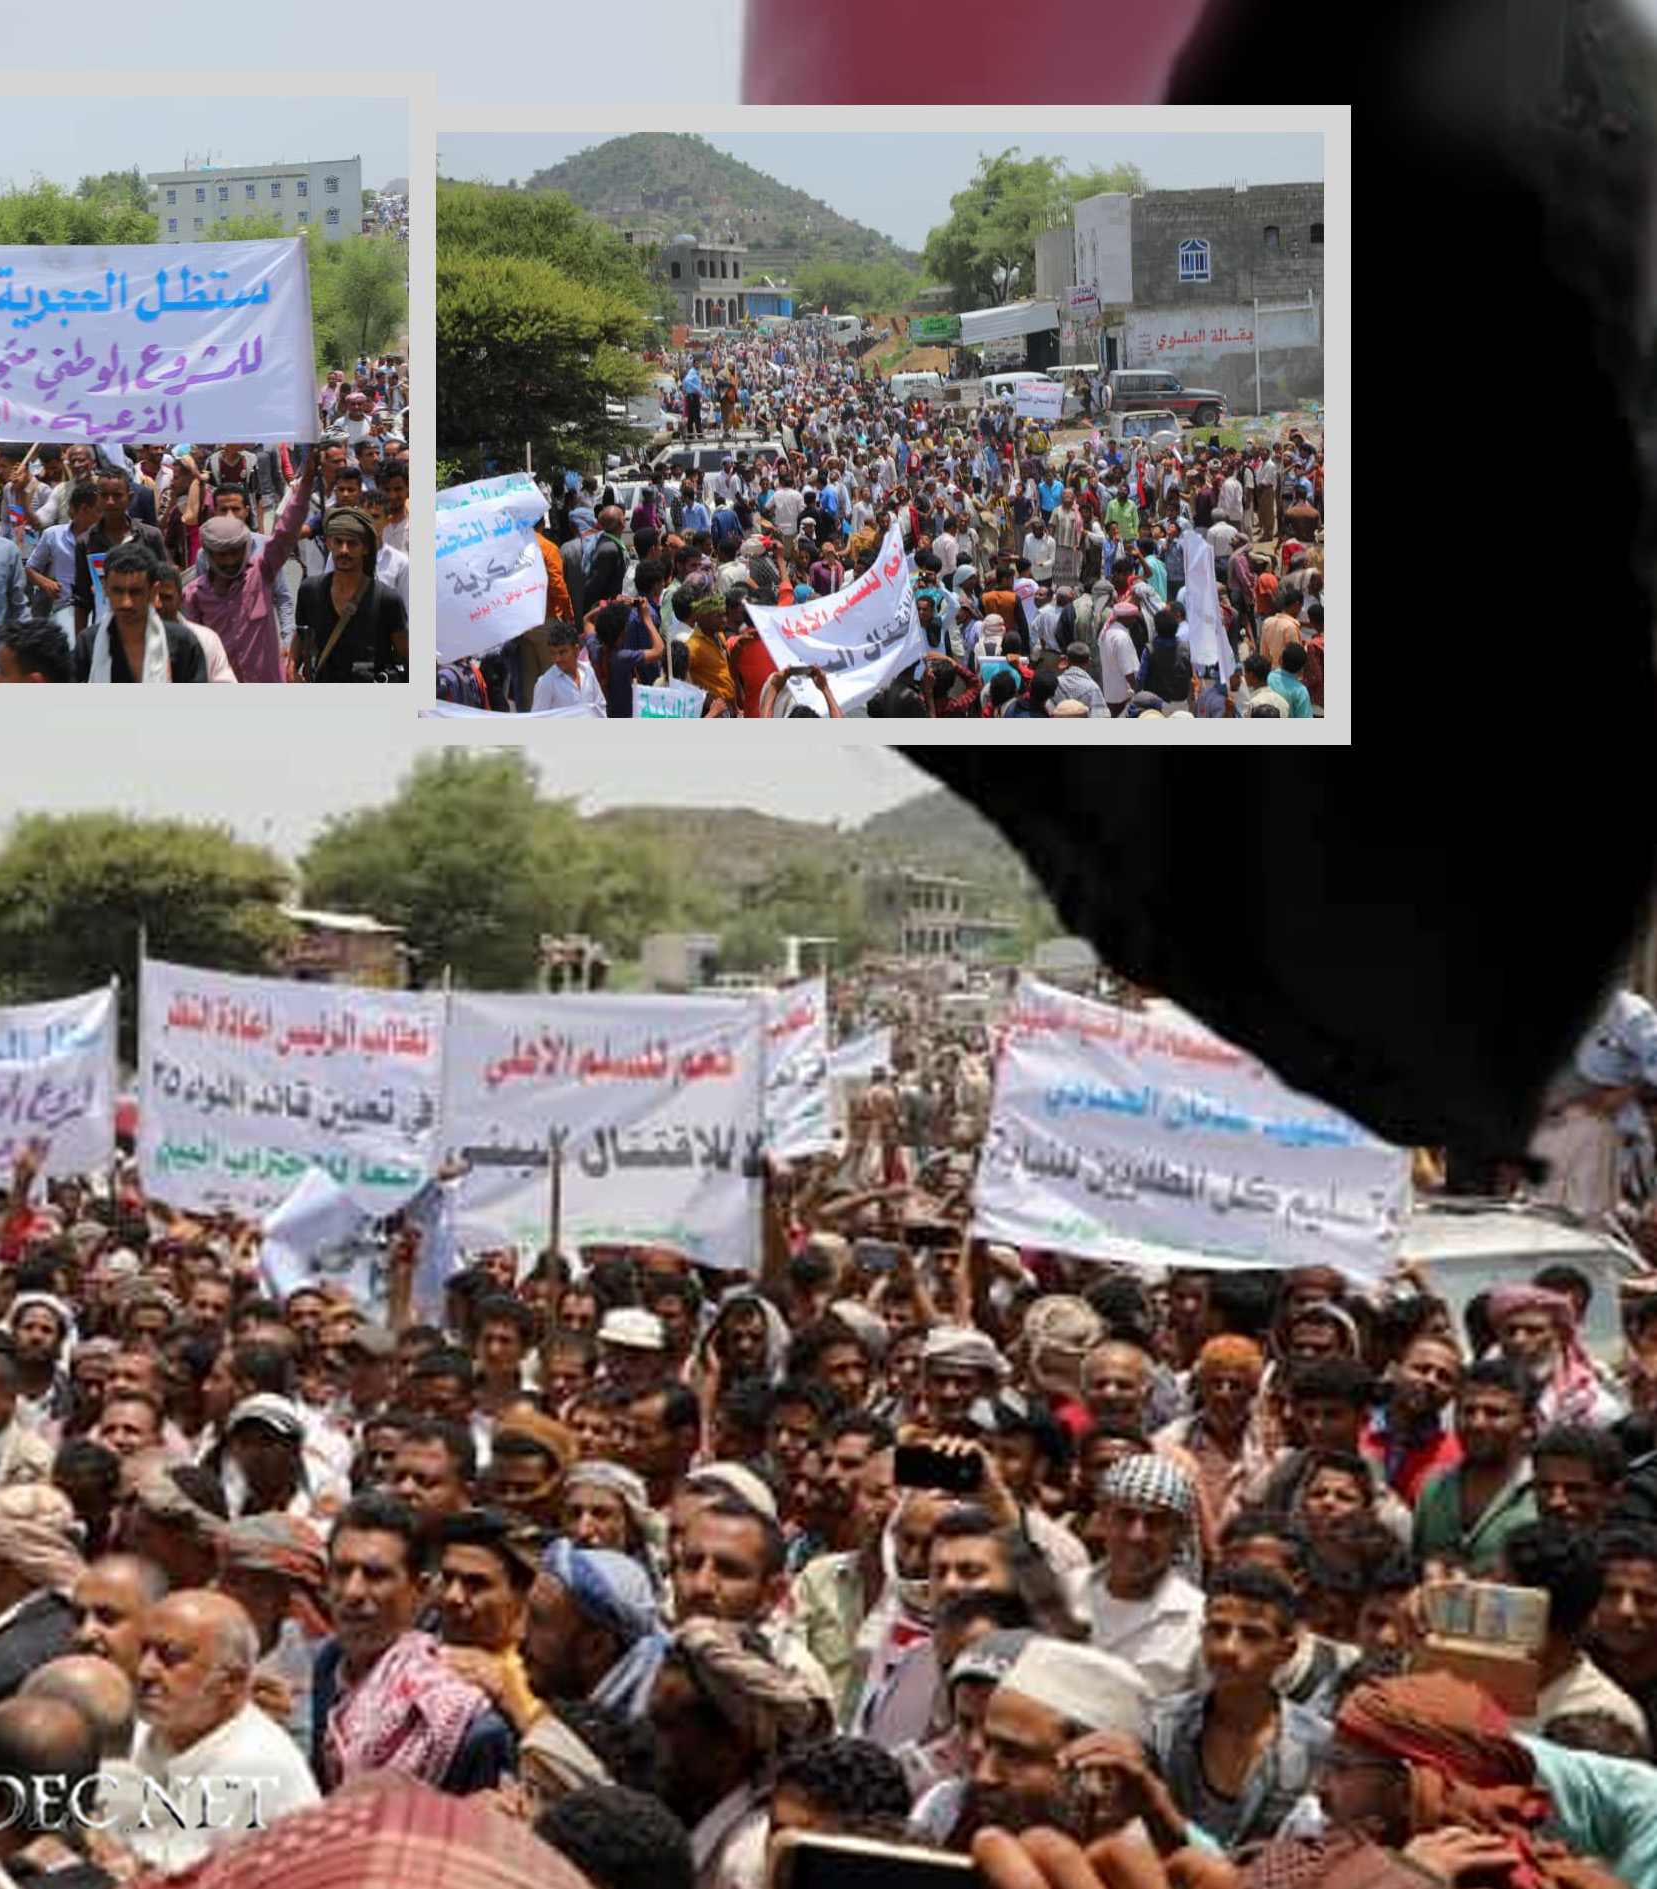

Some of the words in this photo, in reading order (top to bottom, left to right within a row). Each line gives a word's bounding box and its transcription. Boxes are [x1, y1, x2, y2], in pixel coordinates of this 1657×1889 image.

[135, 265, 270, 322] ستظل
[35, 336, 130, 402] الوطني
[578, 1034, 670, 1082] للسلم
[674, 1036, 735, 1088] نعم
[1209, 1169, 1280, 1214] كل
